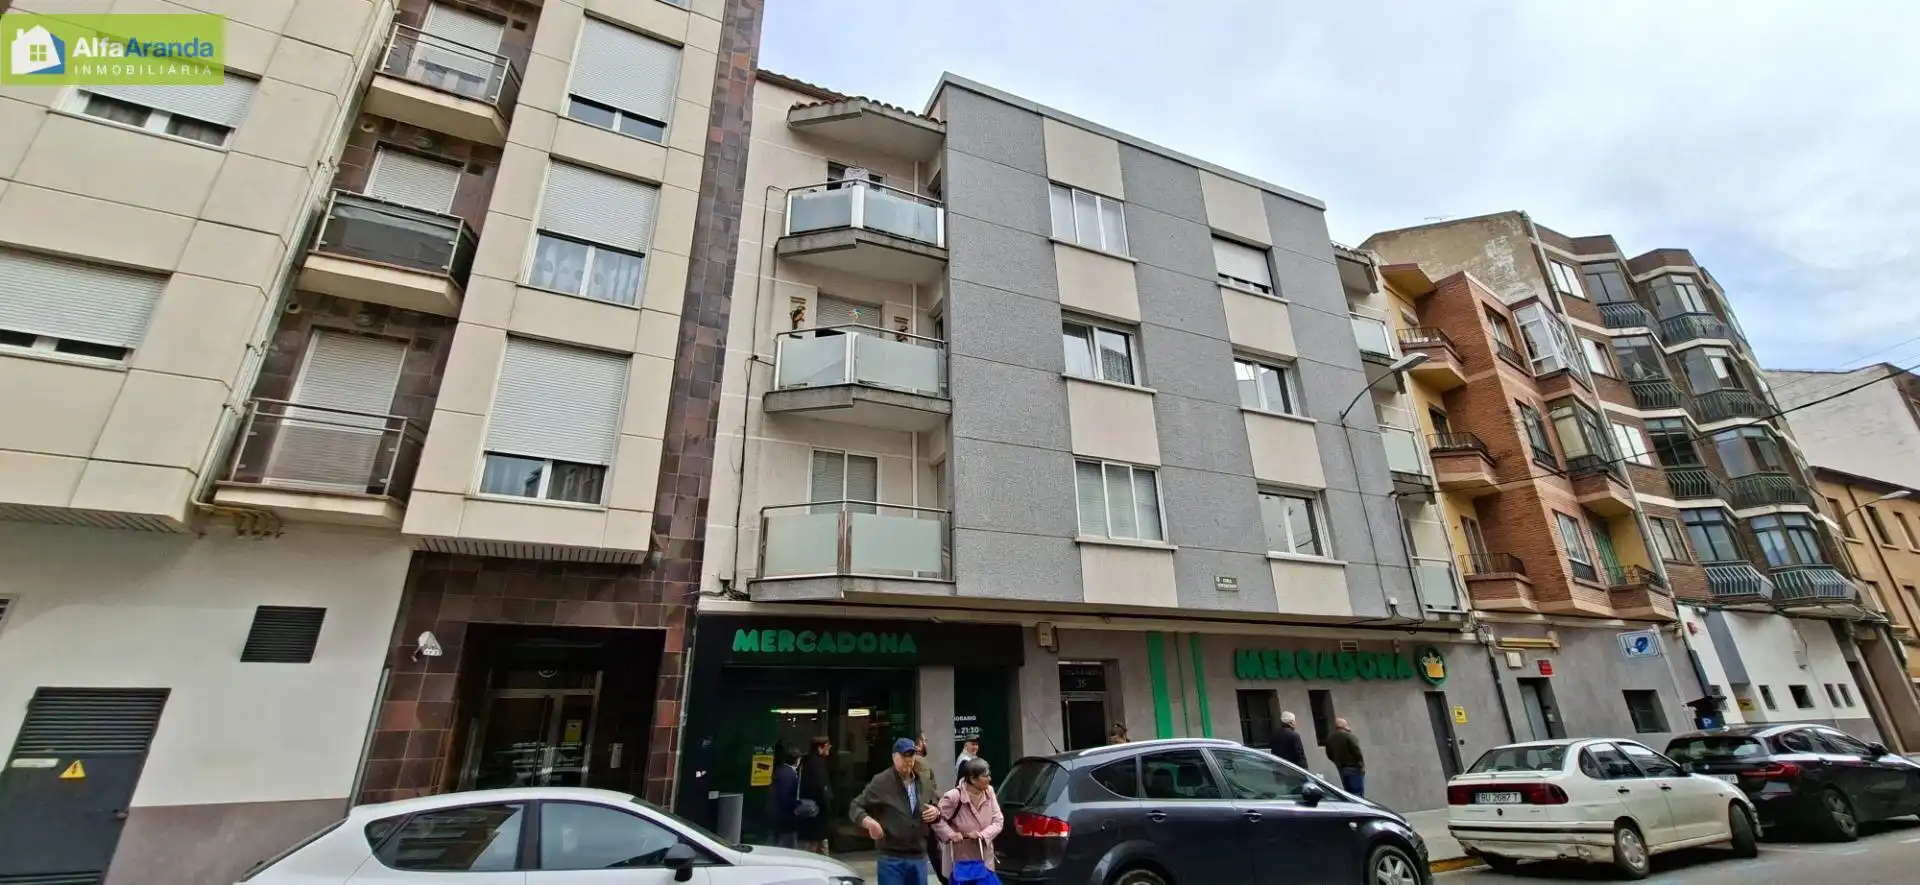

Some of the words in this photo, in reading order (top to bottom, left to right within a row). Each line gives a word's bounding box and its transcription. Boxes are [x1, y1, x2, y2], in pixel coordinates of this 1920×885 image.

[732, 628, 917, 654] MERCADONA
[1234, 648, 1414, 682] MERCADONA
[1702, 717, 1712, 728] P
